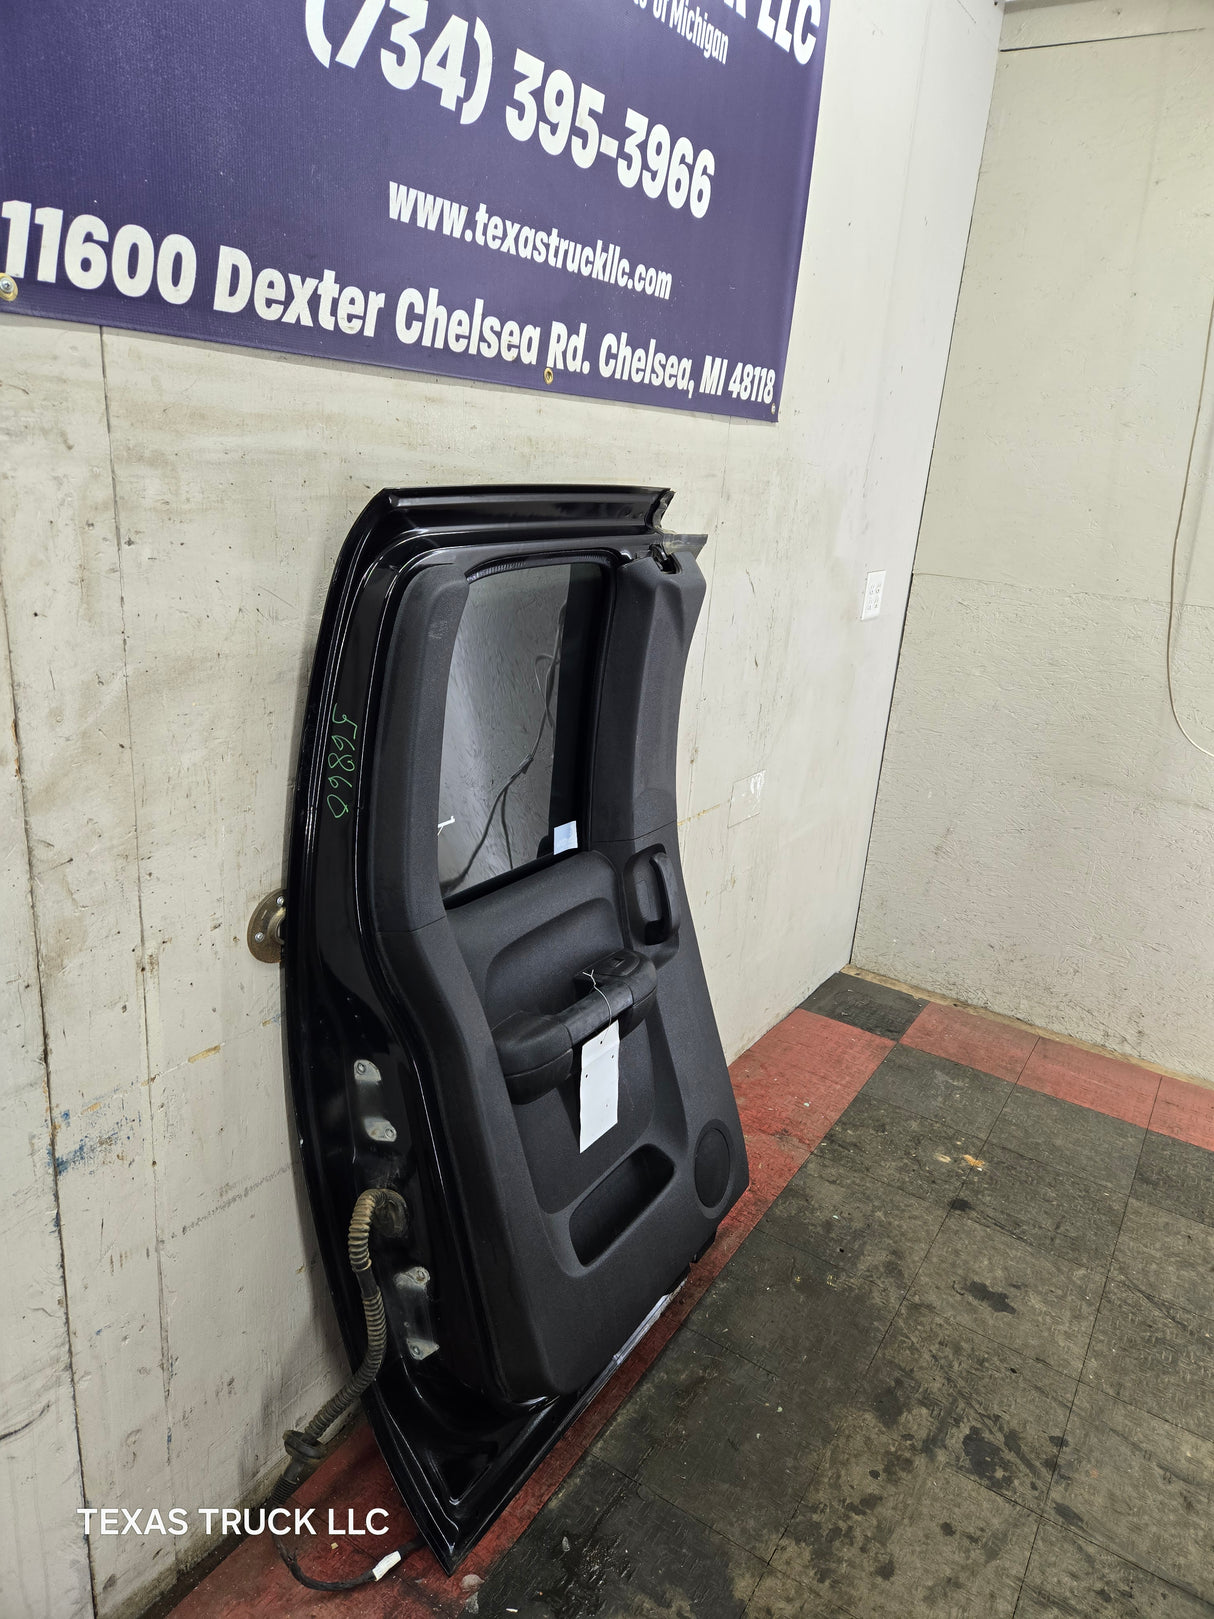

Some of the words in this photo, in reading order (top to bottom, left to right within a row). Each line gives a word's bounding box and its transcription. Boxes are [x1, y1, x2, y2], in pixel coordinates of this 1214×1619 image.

[668, 0, 729, 65] Michigan
[756, 0, 821, 65] LLC
[506, 47, 716, 219] 395-3966
[389, 180, 673, 300] www.texastruckllc.com
[1, 199, 198, 305] 11600
[213, 244, 386, 338] Dexter
[395, 287, 541, 366] Chelsea
[546, 320, 591, 375] Rd.
[598, 331, 695, 399] Chelsea,
[699, 354, 729, 396] MI
[727, 361, 776, 404] 48118
